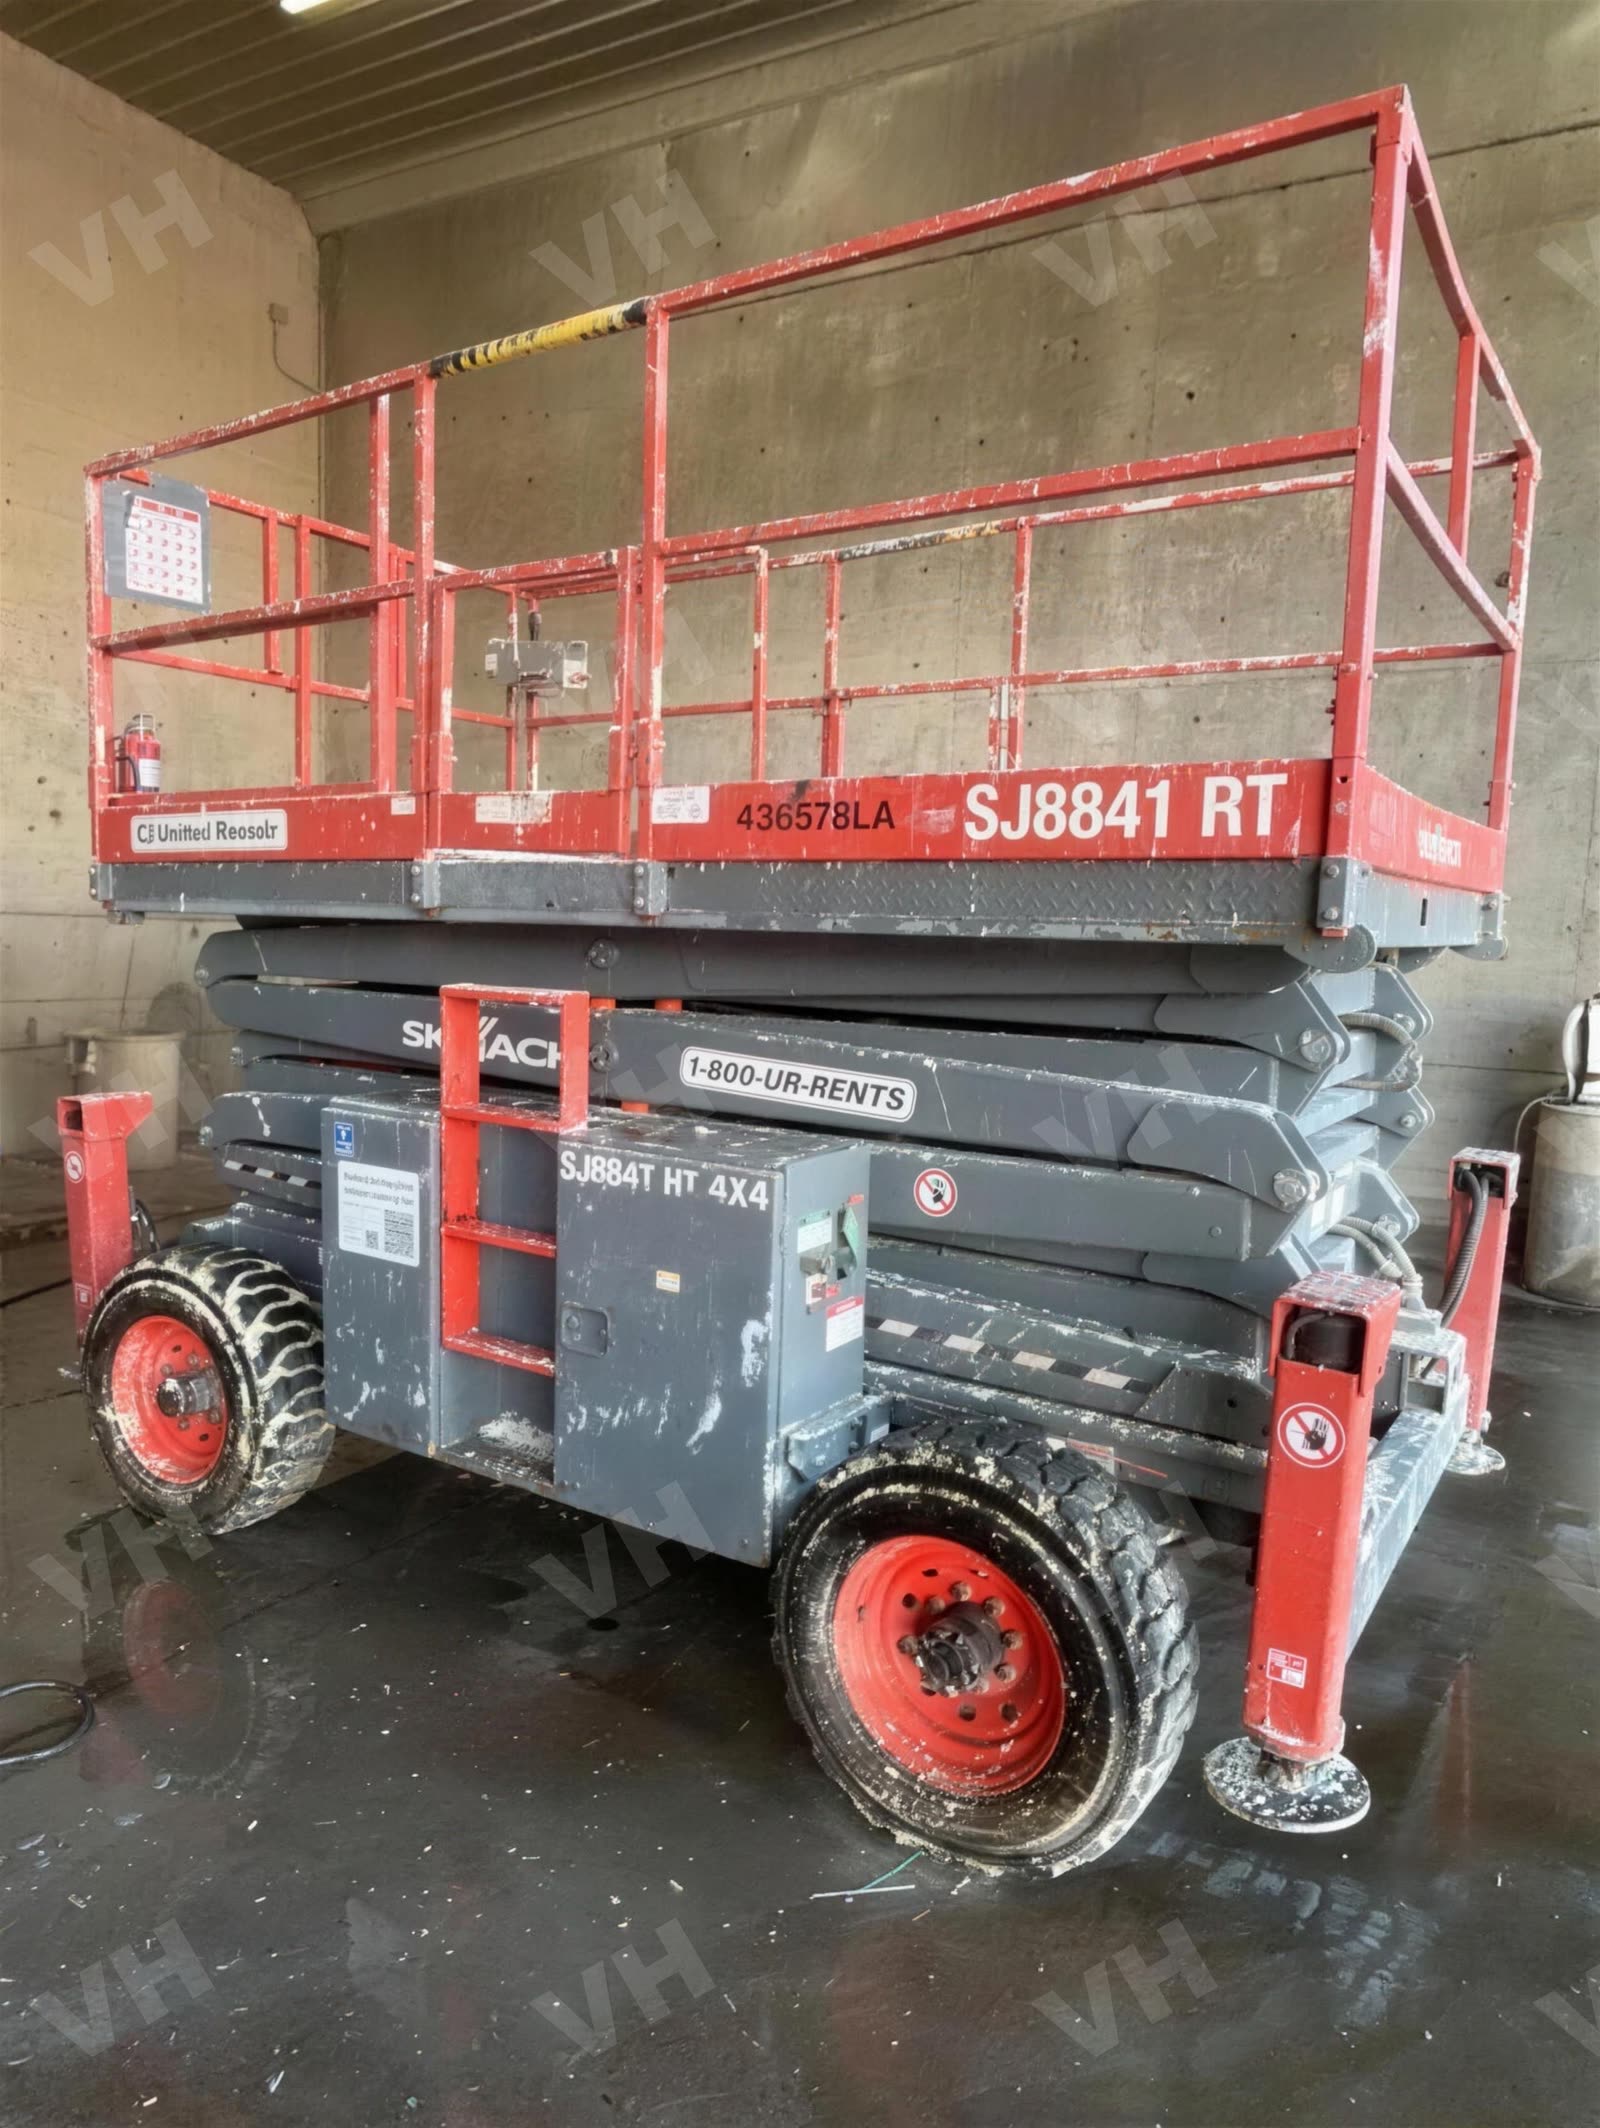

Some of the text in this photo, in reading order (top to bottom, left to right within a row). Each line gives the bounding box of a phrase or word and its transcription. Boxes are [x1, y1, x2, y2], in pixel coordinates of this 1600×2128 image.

[737, 801, 895, 831] 436578LA
[964, 773, 1288, 841] SJ8841 RT
[689, 1056, 906, 1111] 1-800-UR-RENTS
[708, 1174, 769, 1211] 4X4
